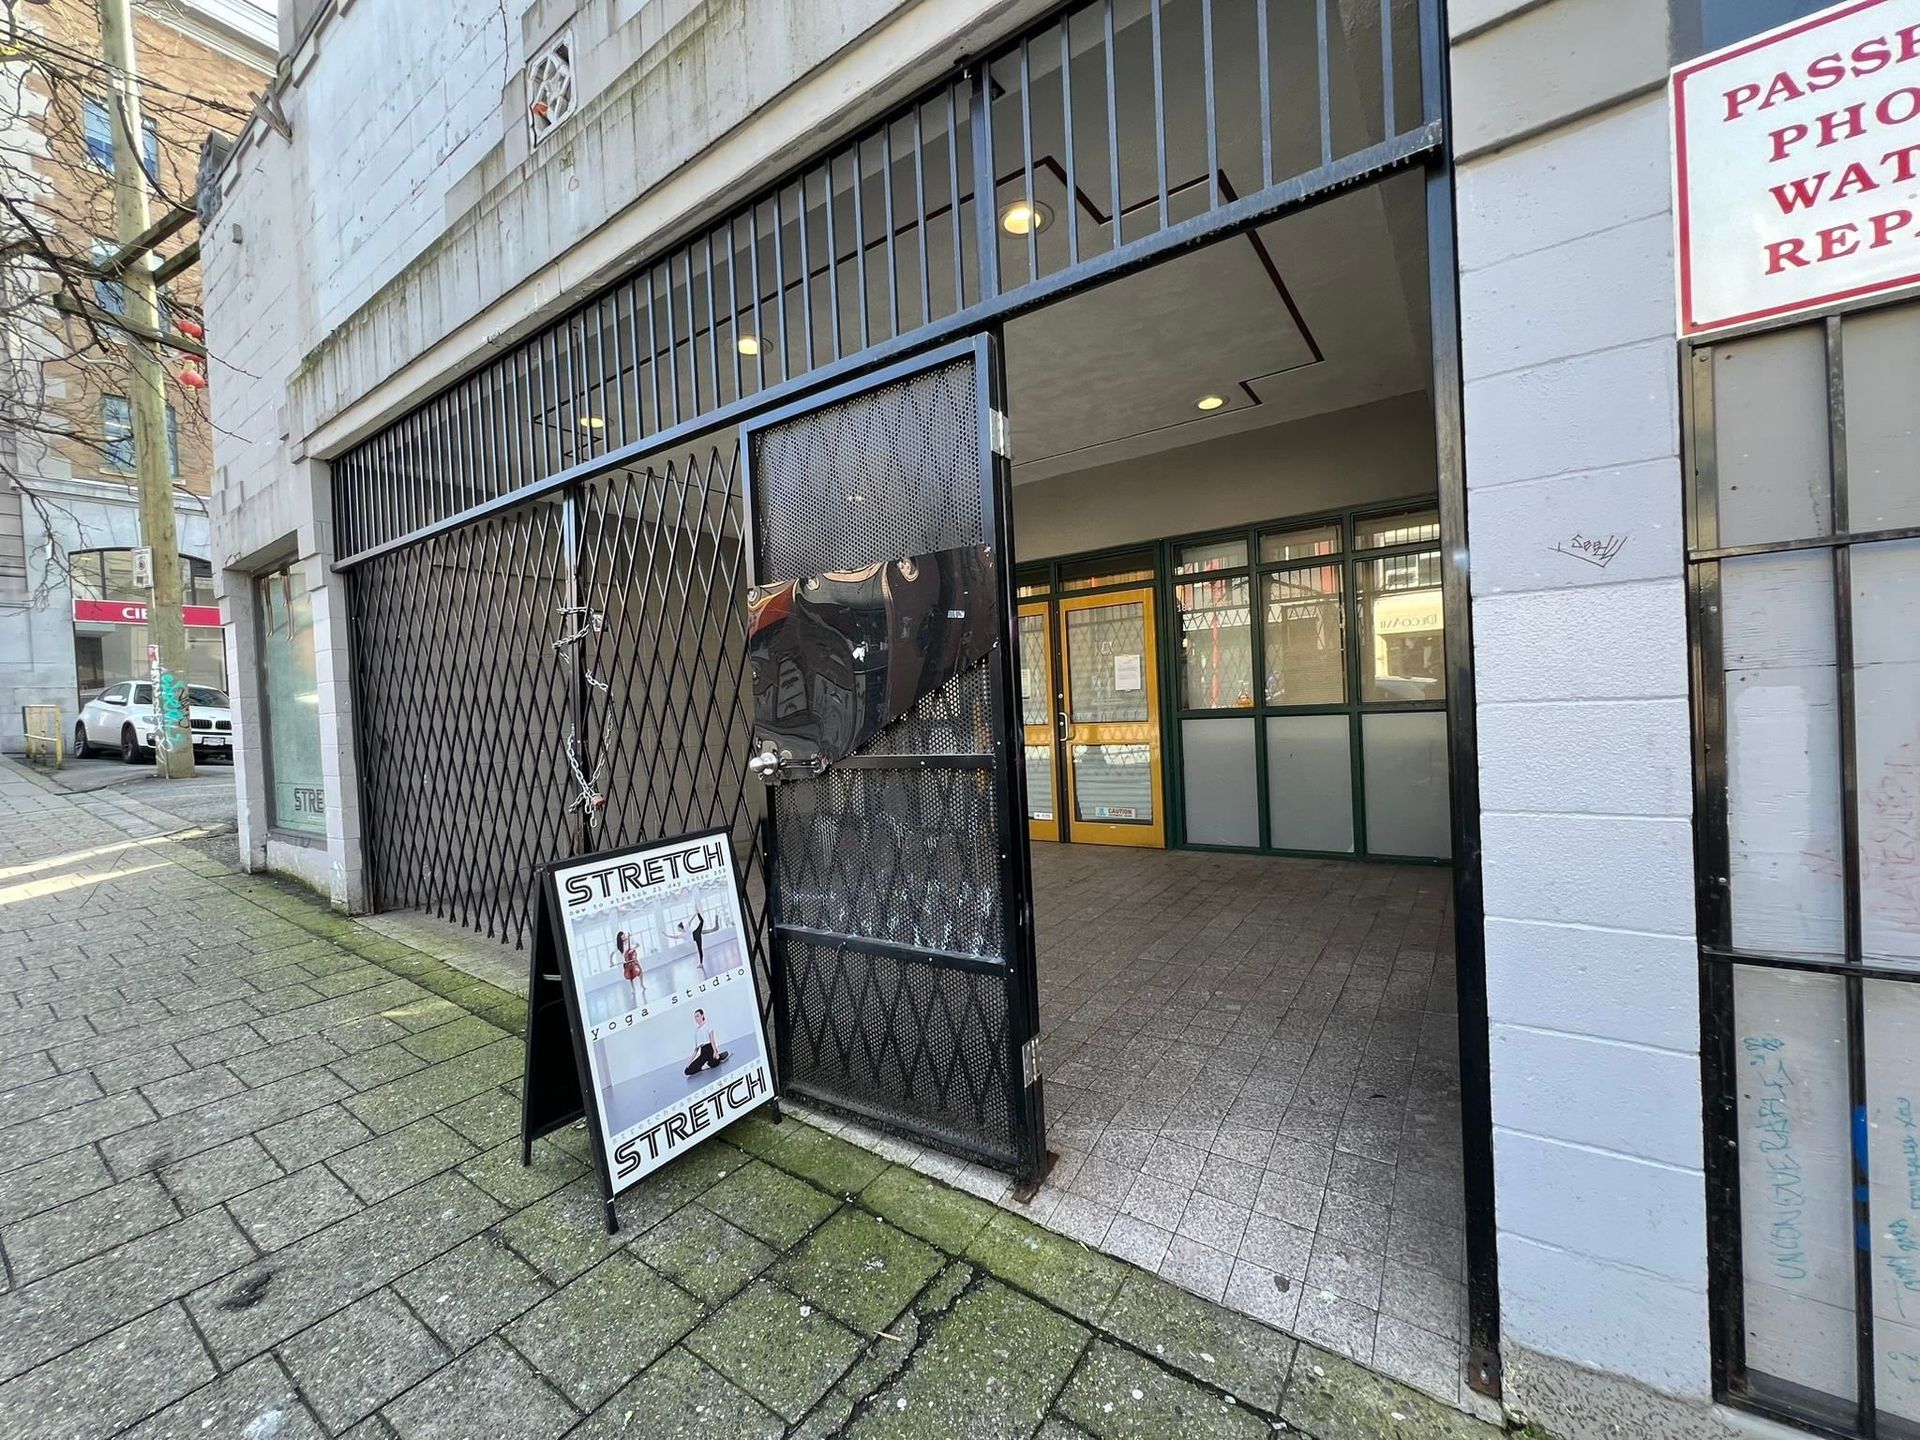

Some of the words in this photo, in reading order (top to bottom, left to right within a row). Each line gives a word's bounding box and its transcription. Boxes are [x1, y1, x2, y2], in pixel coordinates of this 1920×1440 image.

[1768, 86, 1920, 163] PHO
[1768, 143, 1920, 215] WAT
[1764, 209, 1920, 275] REP
[1108, 807, 1133, 815] CAUTION
[565, 841, 725, 907] STRETCH
[610, 890, 647, 905] stretch
[591, 1008, 649, 1041] yoga
[671, 968, 745, 1005] studio
[614, 1066, 767, 1180] STRETCH
